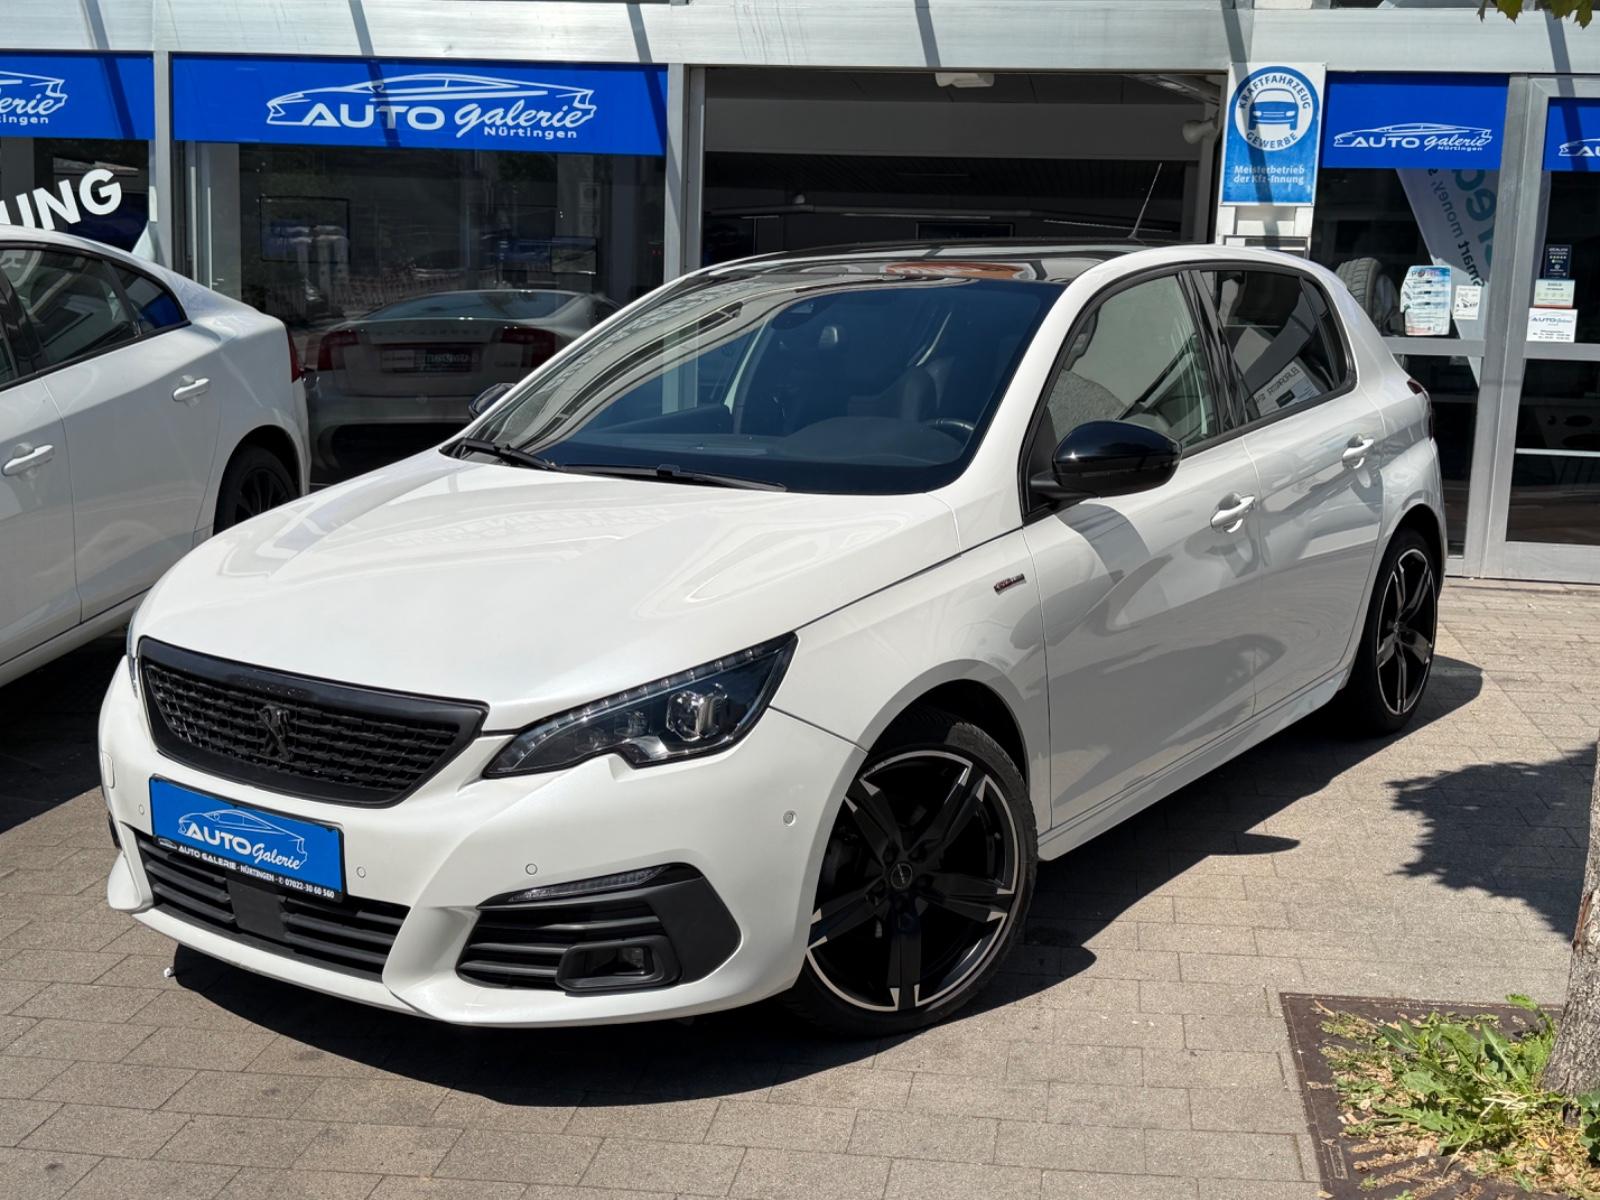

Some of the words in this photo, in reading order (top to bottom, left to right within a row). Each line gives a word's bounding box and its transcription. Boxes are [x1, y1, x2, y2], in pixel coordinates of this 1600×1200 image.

[1239, 75, 1311, 110] KRAFTFAHRZEUG
[301, 102, 446, 131] AUTO
[454, 99, 586, 139] galerie
[484, 126, 577, 140] Nürtingen
[1246, 132, 1297, 149] GEWERBE
[1350, 136, 1420, 149] AUTO
[1423, 133, 1485, 151] galerie
[1233, 174, 1250, 184] der
[1234, 165, 1305, 175] Meisterbetrieb
[185, 822, 252, 856] AUTO
[251, 843, 300, 870] Galerie
[178, 845, 201, 859] AUTO
[201, 853, 237, 871] GALERIE
